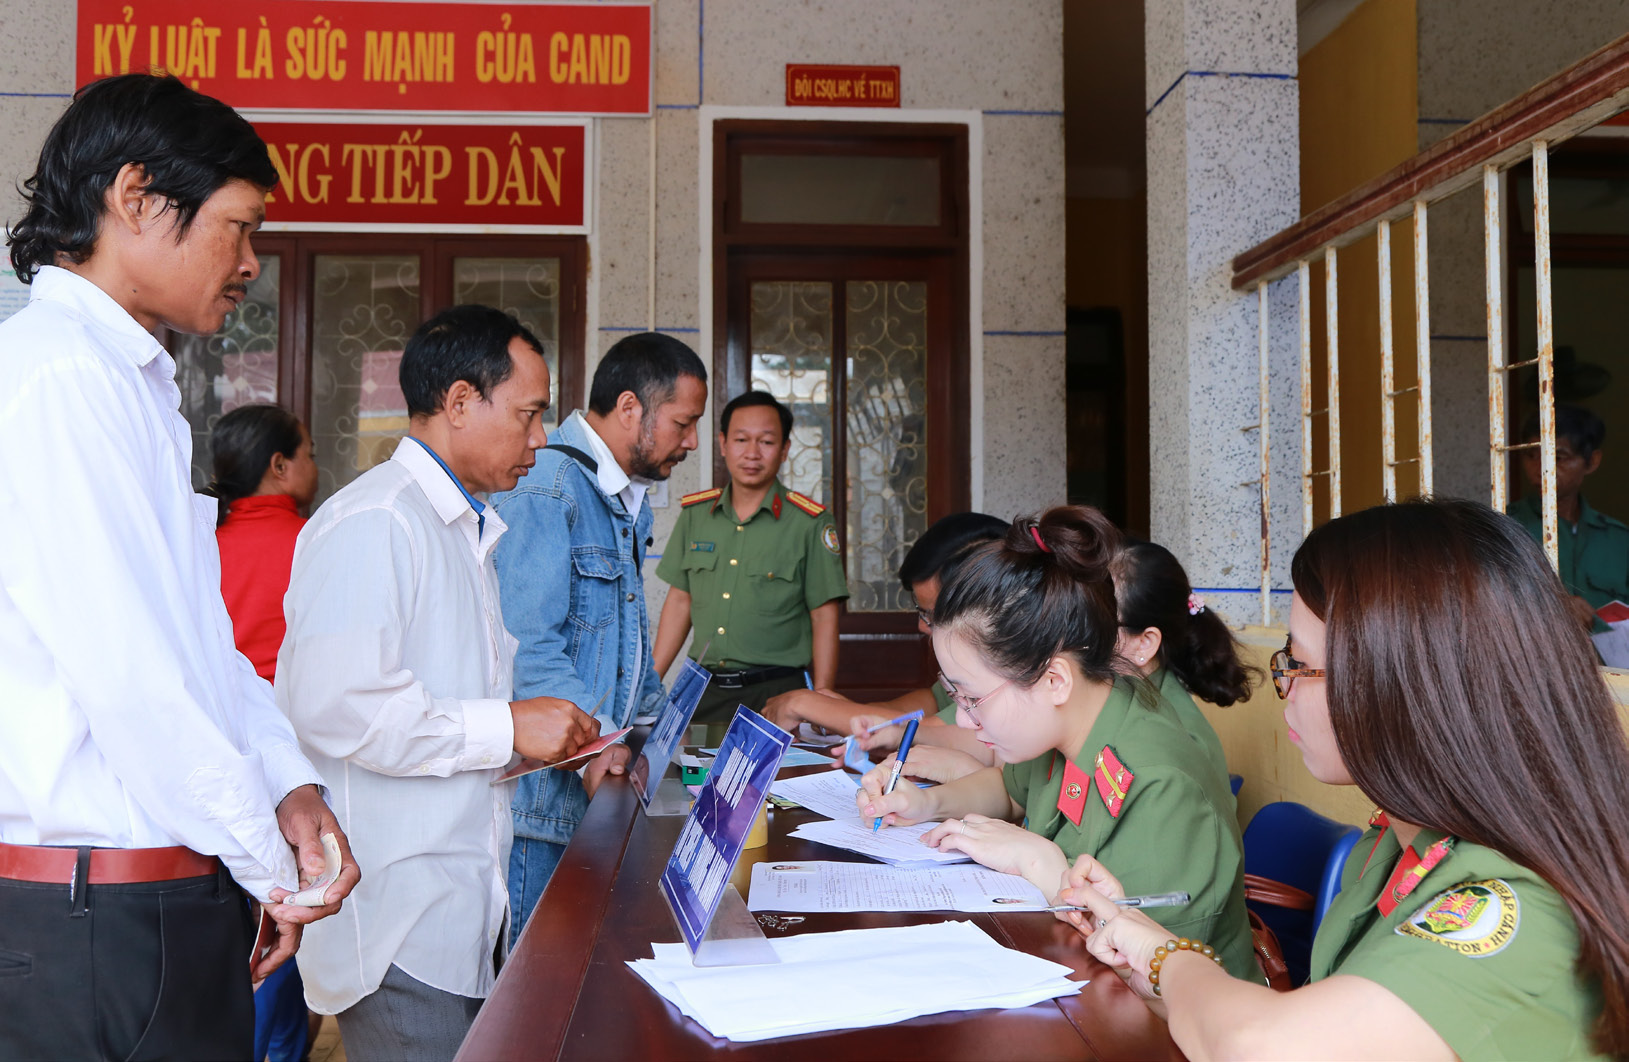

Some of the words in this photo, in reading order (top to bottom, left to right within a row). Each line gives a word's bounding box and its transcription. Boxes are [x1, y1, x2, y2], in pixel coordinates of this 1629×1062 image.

[93, 5, 137, 76] KỶ
[150, 17, 221, 91] LUẬT
[236, 15, 274, 79] LÀ
[285, 15, 347, 81] SỨC
[363, 30, 455, 94] MẠNH
[476, 13, 536, 84] CỦA
[549, 31, 631, 85] CAND
[262, 142, 333, 205] NG
[341, 128, 453, 205] TIẾP
[463, 130, 566, 207] DÂN
